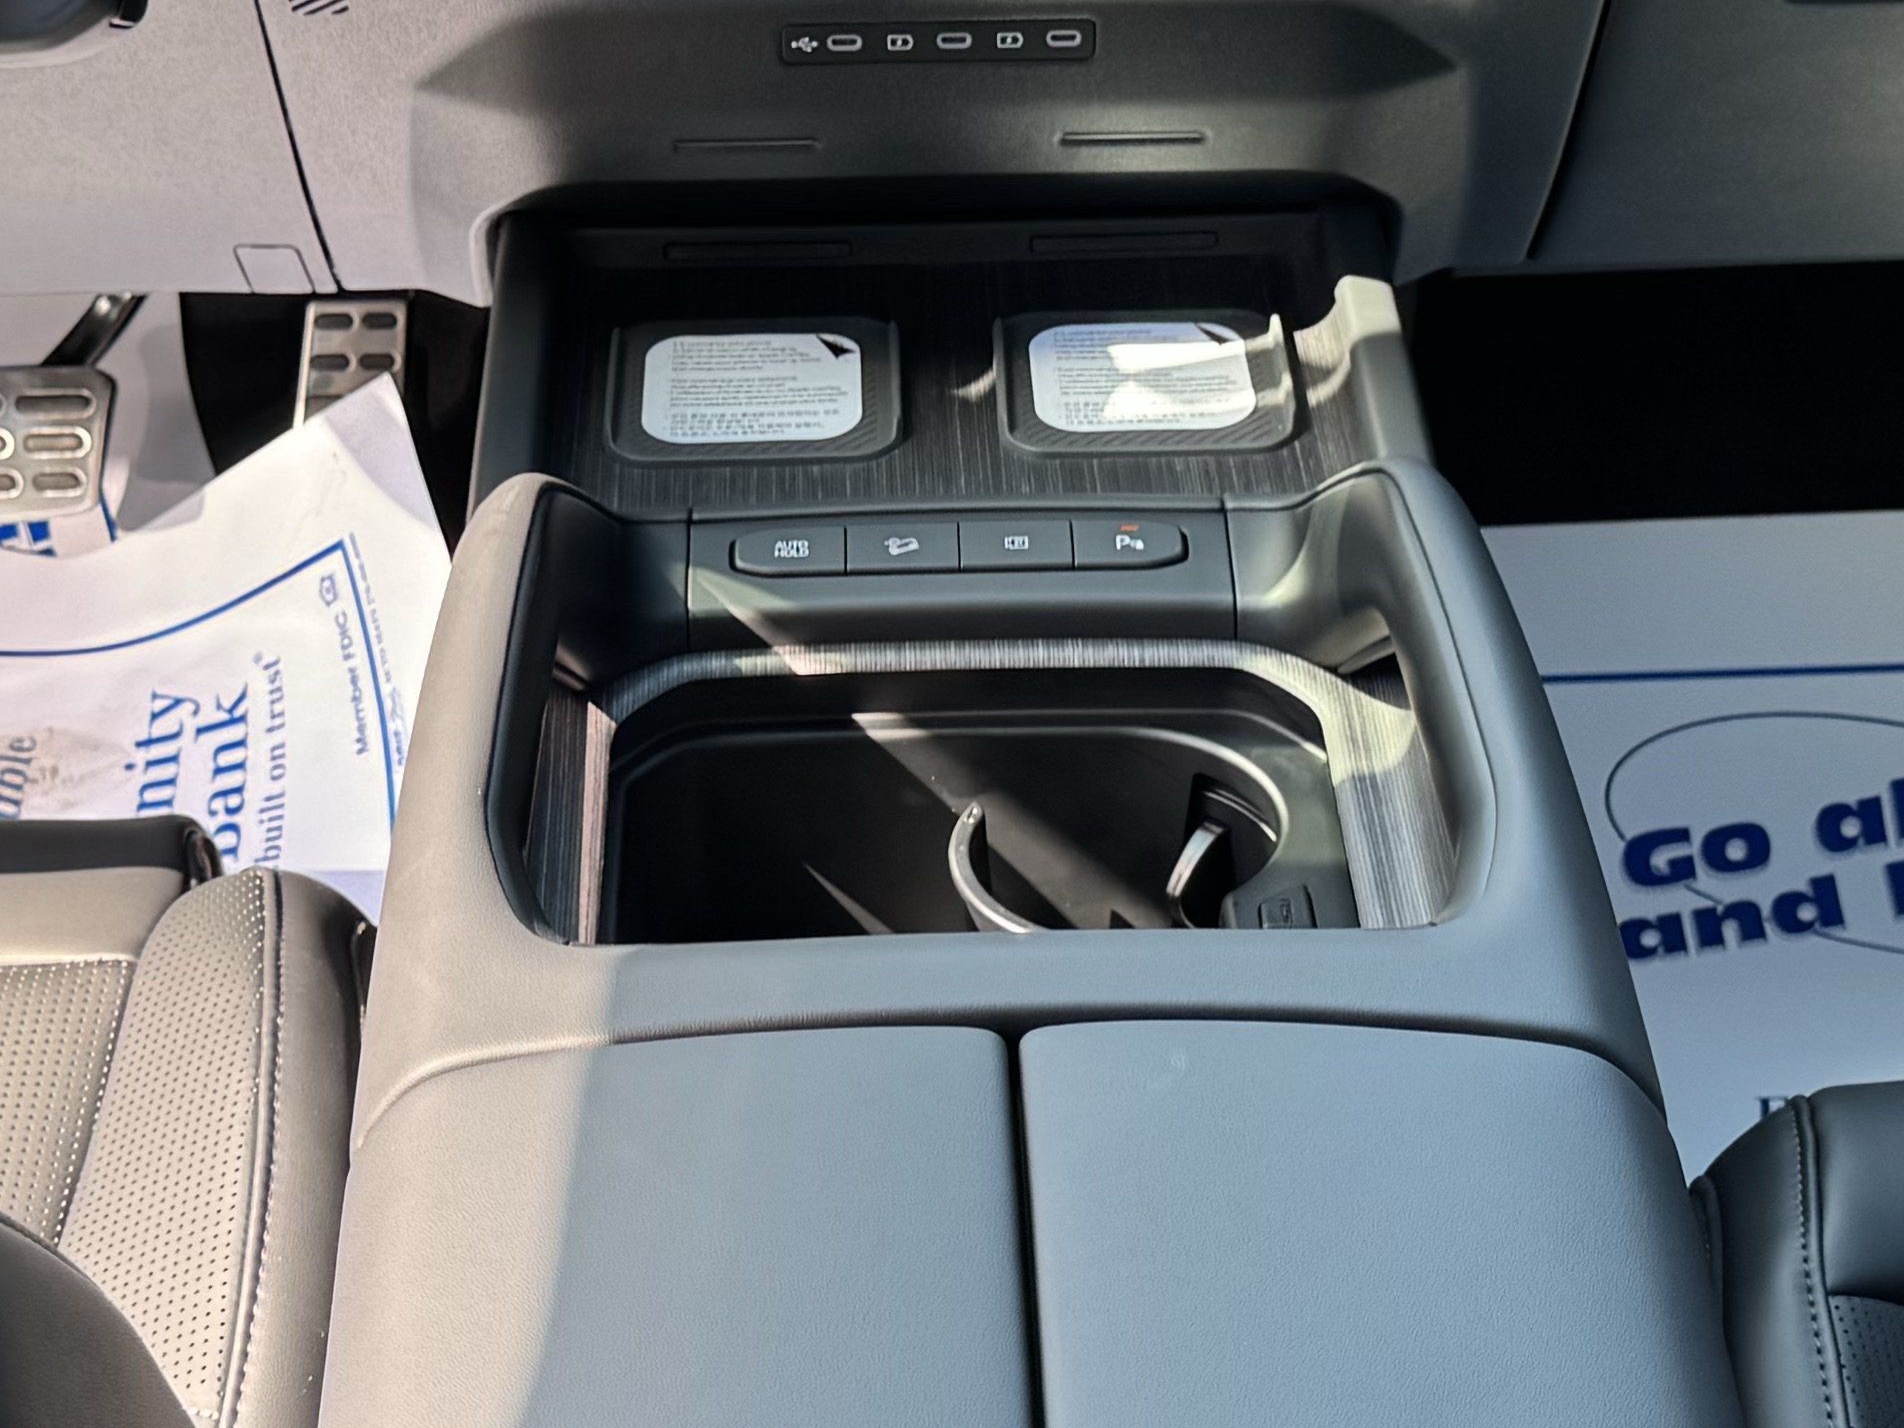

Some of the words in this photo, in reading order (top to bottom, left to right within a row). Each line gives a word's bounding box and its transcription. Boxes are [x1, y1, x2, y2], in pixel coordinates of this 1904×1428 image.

[774, 548, 809, 558] HOLD
[775, 539, 809, 549] AUTO
[334, 610, 356, 663] FDIC
[348, 666, 370, 756] Member
[124, 689, 201, 815] nity
[194, 681, 249, 861] bank
[269, 741, 286, 782] on
[254, 790, 286, 864] built
[1621, 816, 1772, 889] Go
[1618, 875, 1846, 961] and
